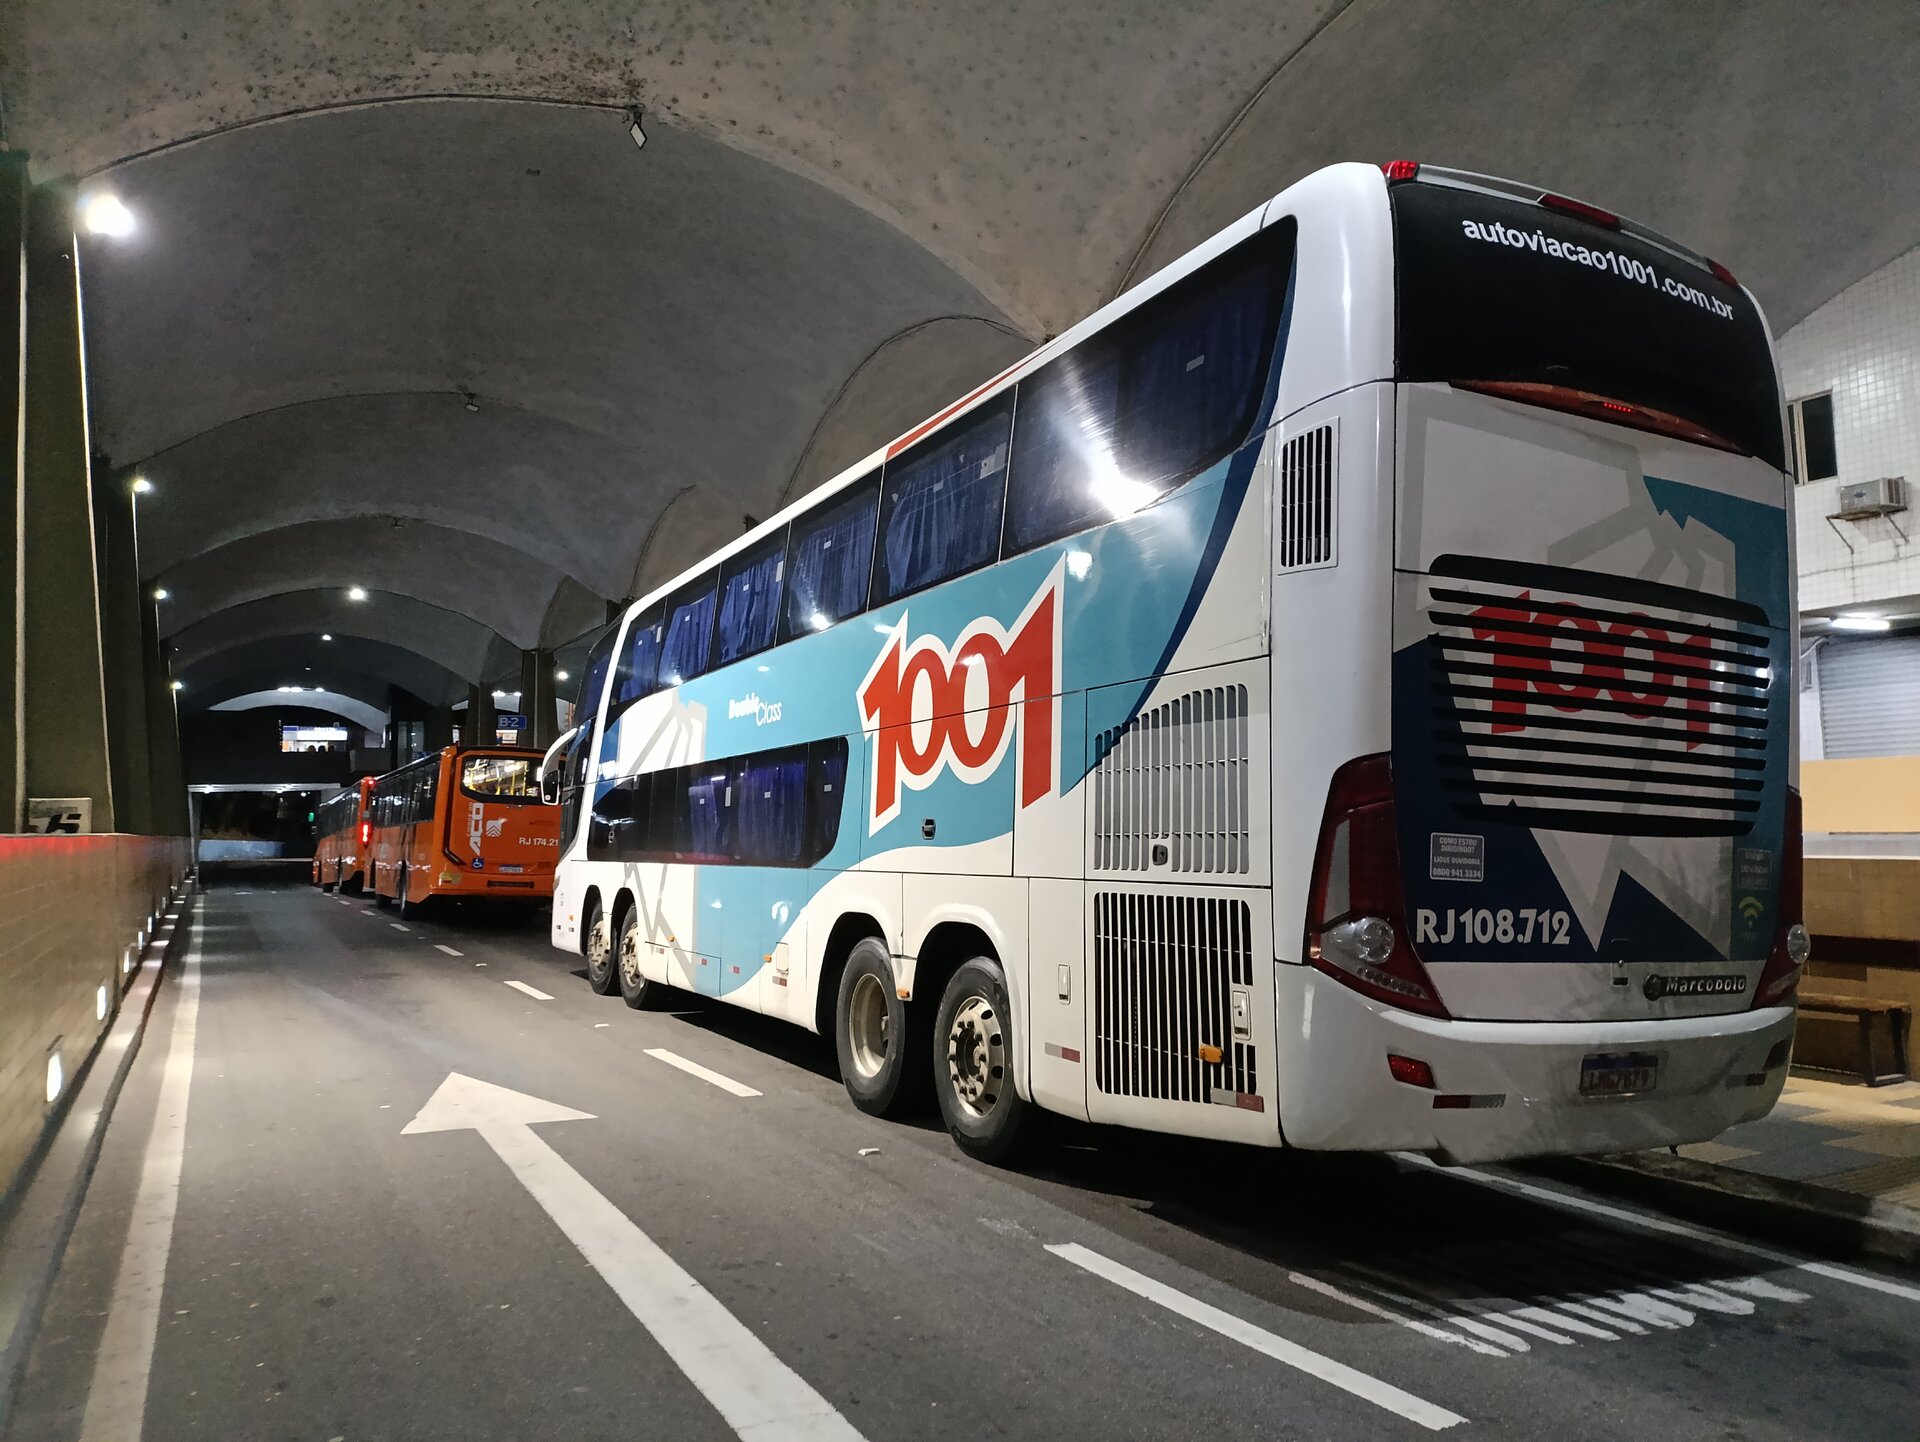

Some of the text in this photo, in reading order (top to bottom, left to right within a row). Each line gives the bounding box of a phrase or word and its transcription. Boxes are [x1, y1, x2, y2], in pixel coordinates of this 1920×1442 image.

[1462, 219, 1734, 321] autoviacao1001.com.br
[859, 562, 1062, 832] 1001
[499, 716, 520, 728] B-2
[756, 701, 782, 727] Class
[518, 837, 532, 845] RJ
[1458, 838, 1477, 846] ESTOU
[1416, 908, 1571, 945] RJ 108.712
